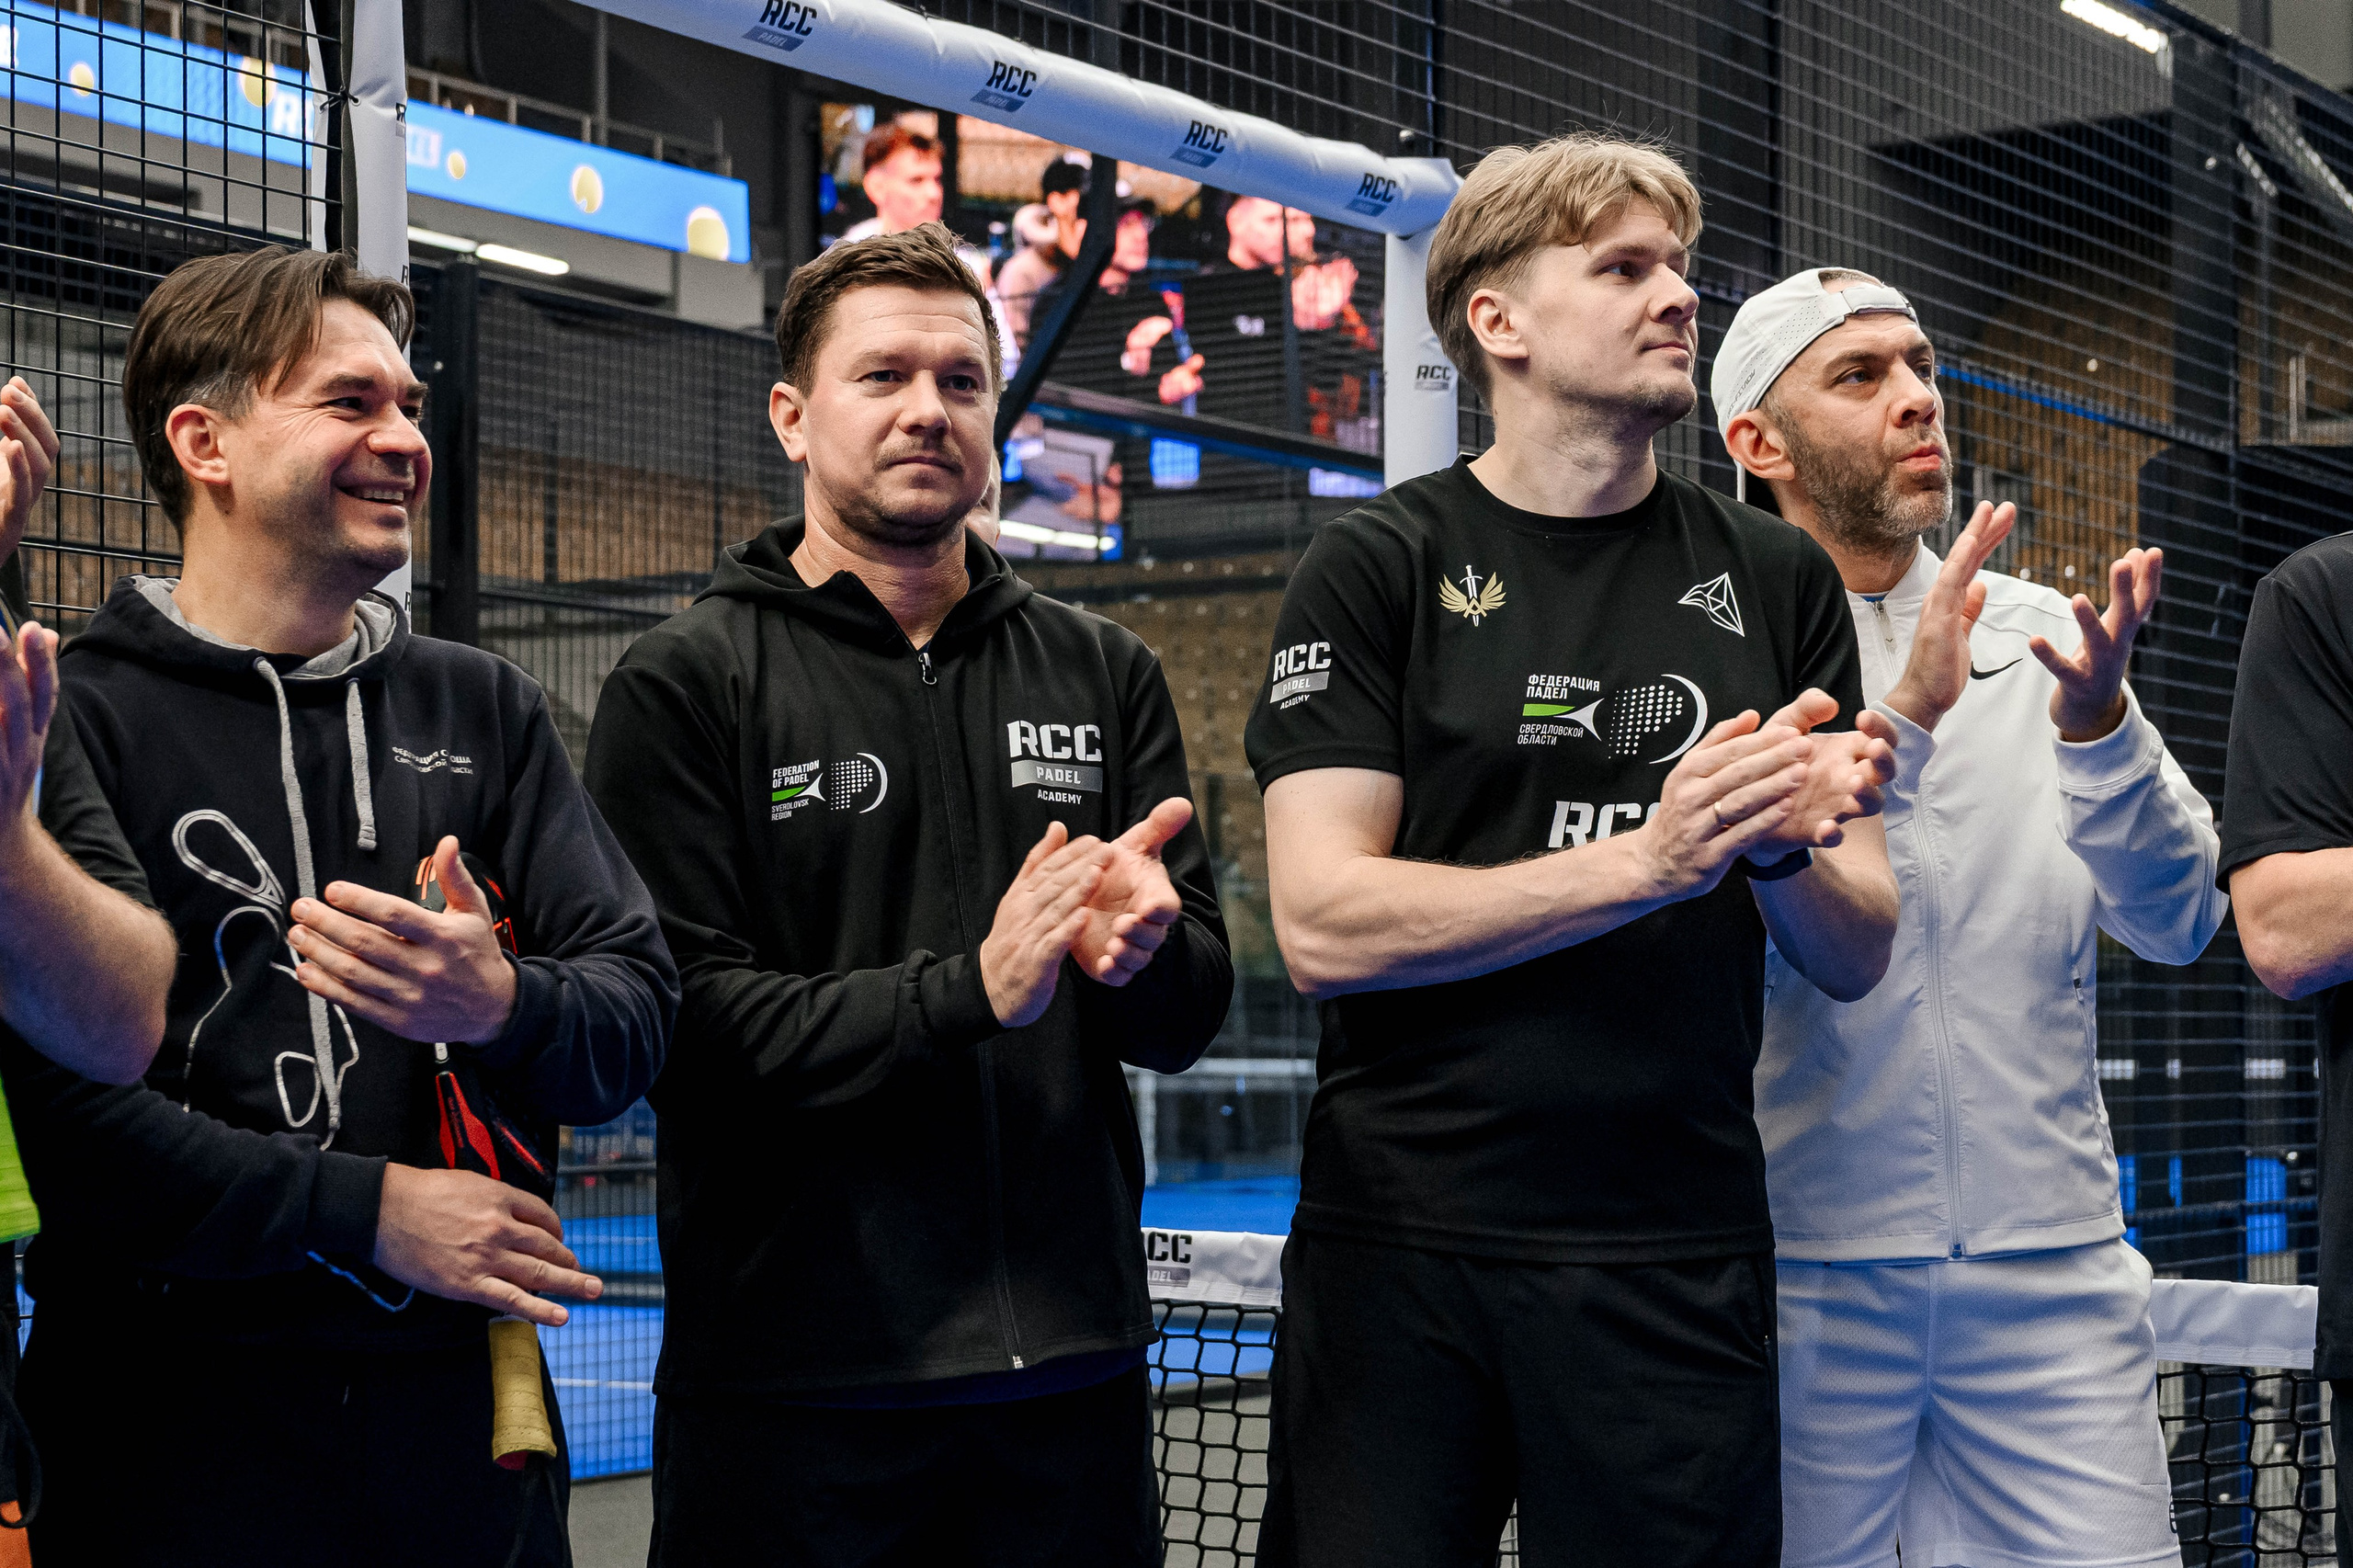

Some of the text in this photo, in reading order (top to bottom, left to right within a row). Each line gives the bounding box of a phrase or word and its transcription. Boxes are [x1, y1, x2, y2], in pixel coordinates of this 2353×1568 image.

[759, 0, 817, 36] RCC
[986, 60, 1037, 98] RCC
[1184, 119, 1228, 153] RCC
[1358, 172, 1396, 202] RCC
[1416, 364, 1450, 381] RCC
[1273, 642, 1331, 682] RCC
[1282, 677, 1311, 695] PADEL
[1528, 674, 1599, 692] ФЕДЕРАЦИЯ
[1526, 686, 1568, 699] ПАДЕЛ
[1279, 694, 1310, 710] ACADEMY
[1517, 734, 1557, 745] ОБЛАСТИ
[1519, 723, 1584, 738] СВЕРДЛОВСКОЙ
[1007, 720, 1102, 762] RCC
[773, 759, 820, 778] FEDERATION
[1036, 766, 1082, 784] PADEL
[772, 773, 809, 789] OF PADEL
[771, 798, 810, 813] SVERDLOVSK
[1037, 789, 1083, 805] ACADEMY
[771, 810, 792, 821] REGION
[1548, 800, 1661, 847] RC
[1142, 1232, 1192, 1264] CC
[1149, 1269, 1172, 1281] DEL
